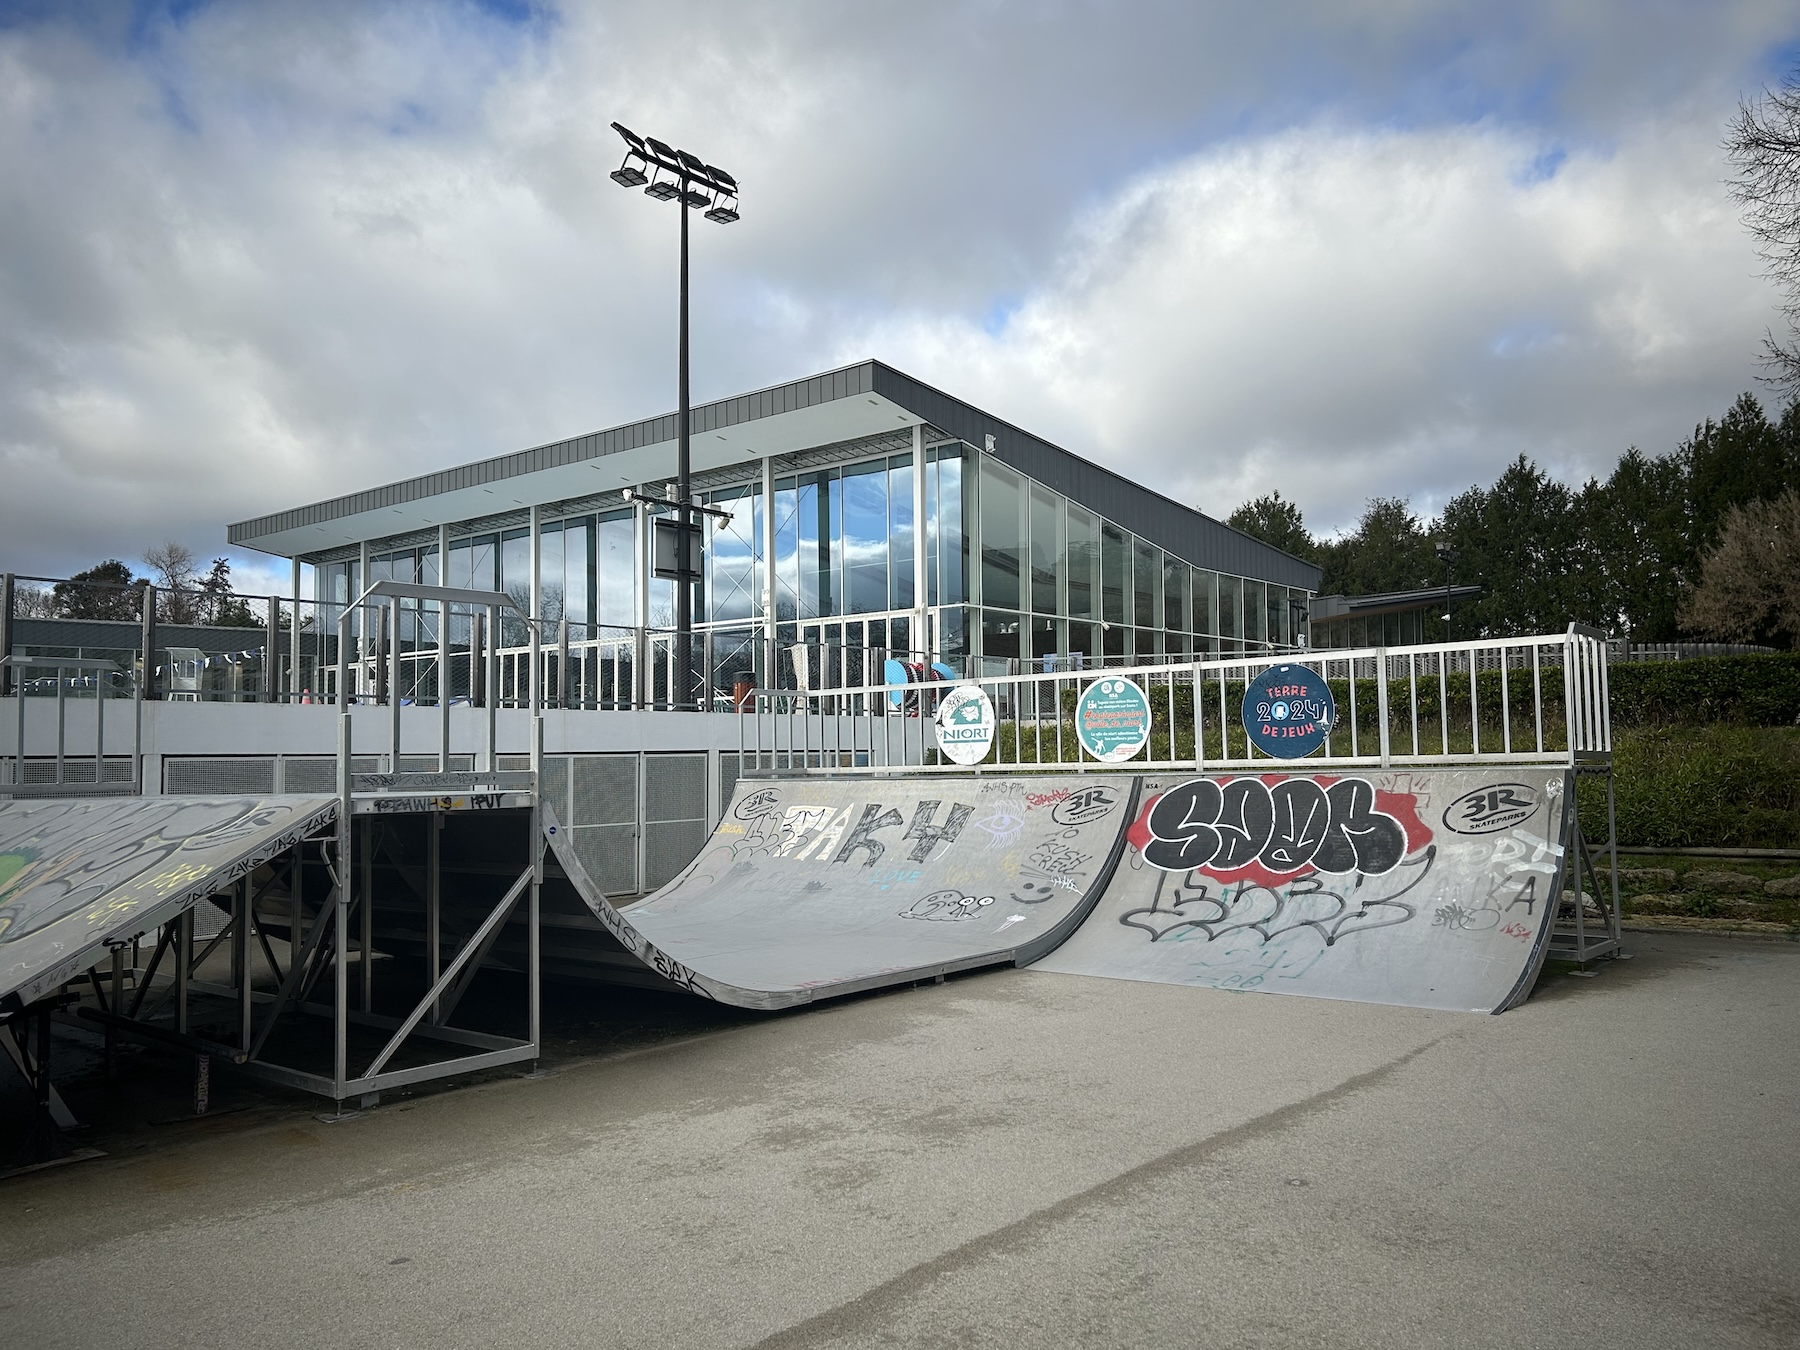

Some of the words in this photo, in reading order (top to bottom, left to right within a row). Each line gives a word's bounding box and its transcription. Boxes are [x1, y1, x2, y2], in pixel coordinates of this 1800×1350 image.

[1266, 685, 1308, 698] TERRE
[1256, 699, 1320, 722] 2024
[943, 727, 989, 740] NIORT
[1261, 723, 1279, 738] DE
[1281, 722, 1316, 738] JEUX
[1065, 790, 1114, 813] 3R
[1461, 789, 1533, 819] 3R
[1068, 807, 1108, 822] SKATEPARKS
[1469, 811, 1526, 830] SKATEPARKS
